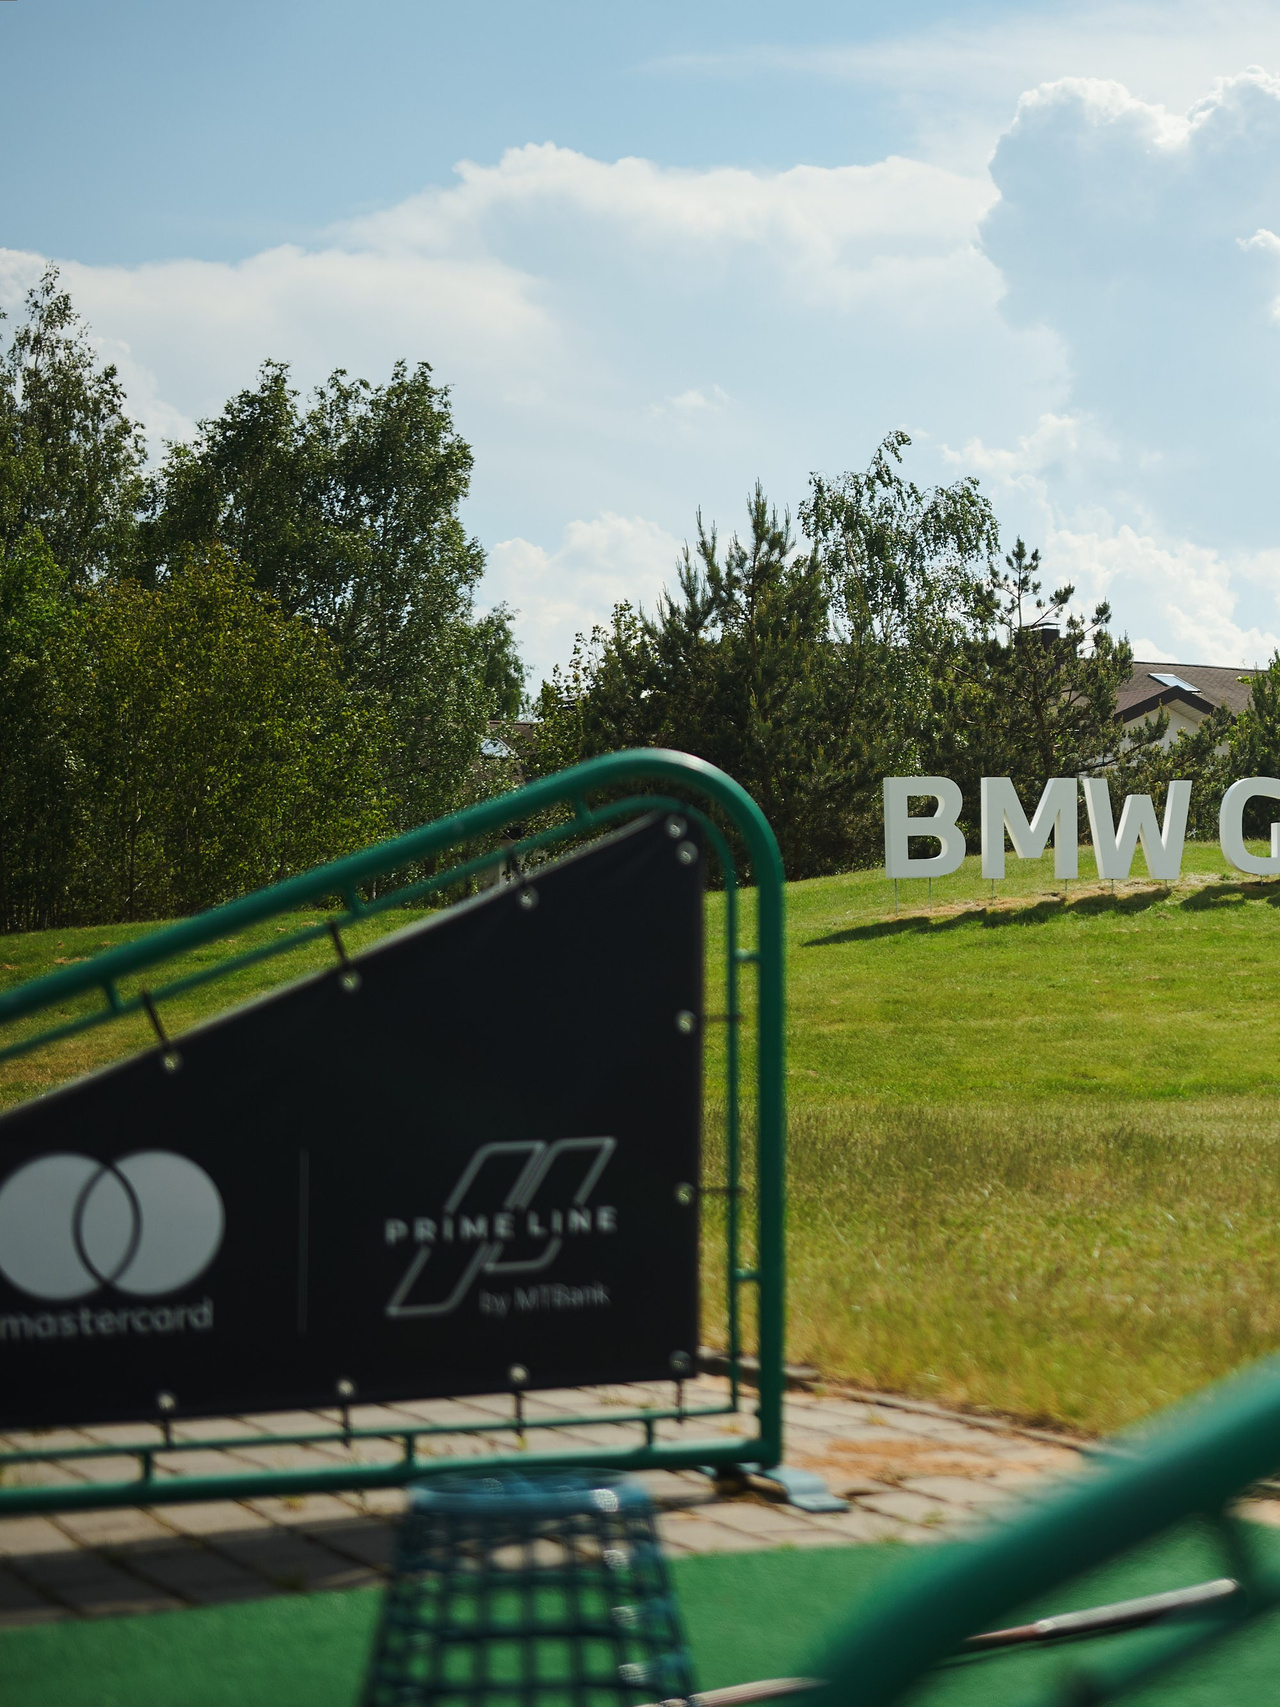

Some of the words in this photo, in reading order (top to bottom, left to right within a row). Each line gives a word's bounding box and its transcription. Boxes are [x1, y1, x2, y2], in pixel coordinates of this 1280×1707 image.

[883, 776, 1192, 880] BMW
[385, 1212, 515, 1245] PRIME
[527, 1206, 617, 1238] LINE
[0, 1297, 214, 1338] mastercard
[479, 1288, 511, 1317] by
[514, 1281, 611, 1310] MTBank
